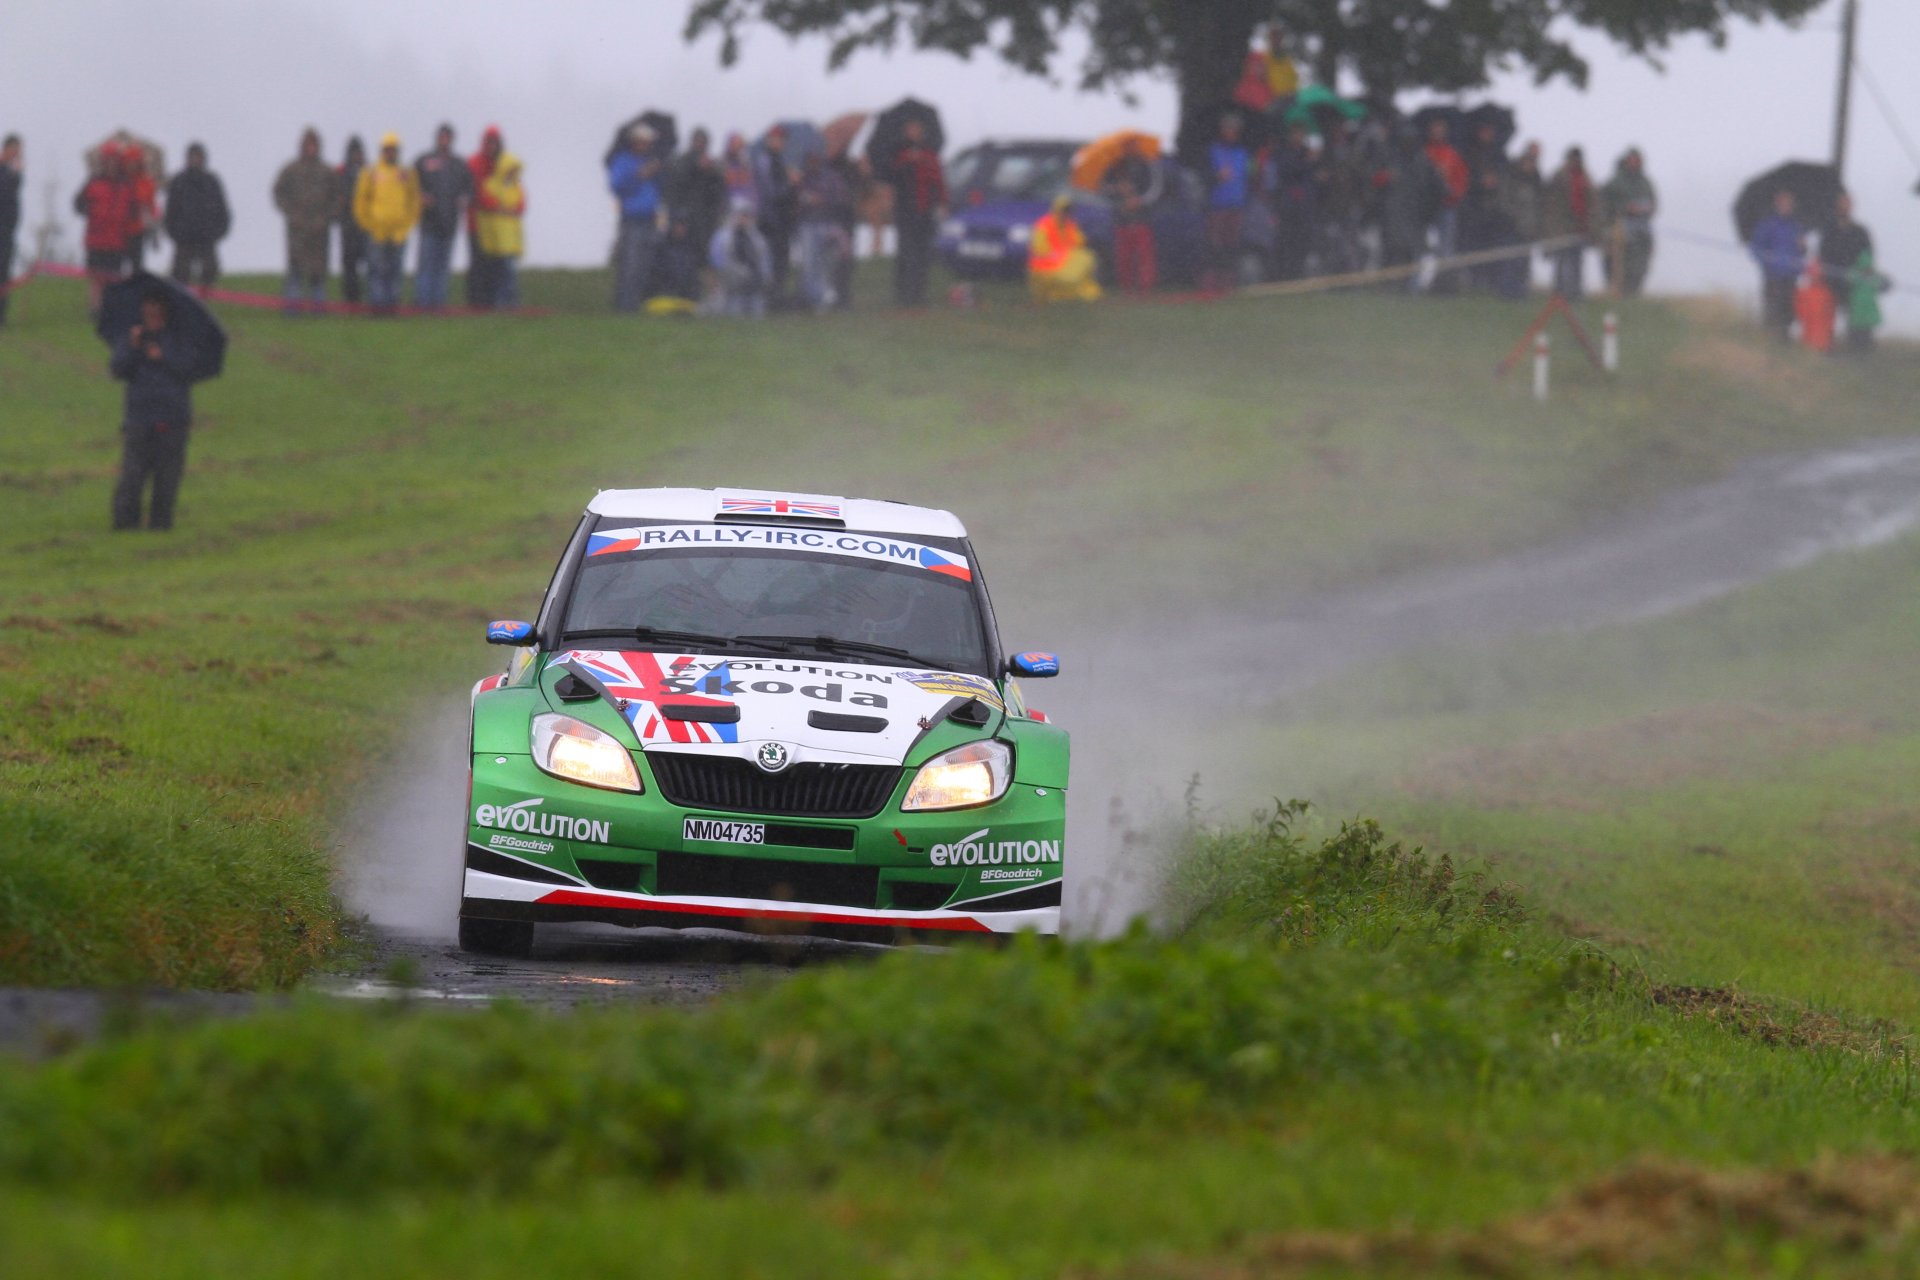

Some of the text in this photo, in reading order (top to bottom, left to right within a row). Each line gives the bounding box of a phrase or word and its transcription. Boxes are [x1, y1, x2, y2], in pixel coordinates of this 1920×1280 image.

[644, 529, 916, 561] RALLY-IRC.COM
[685, 820, 764, 844] NM04735
[490, 834, 554, 852] BFGoodrich
[981, 868, 1043, 880] BFGoodrich
